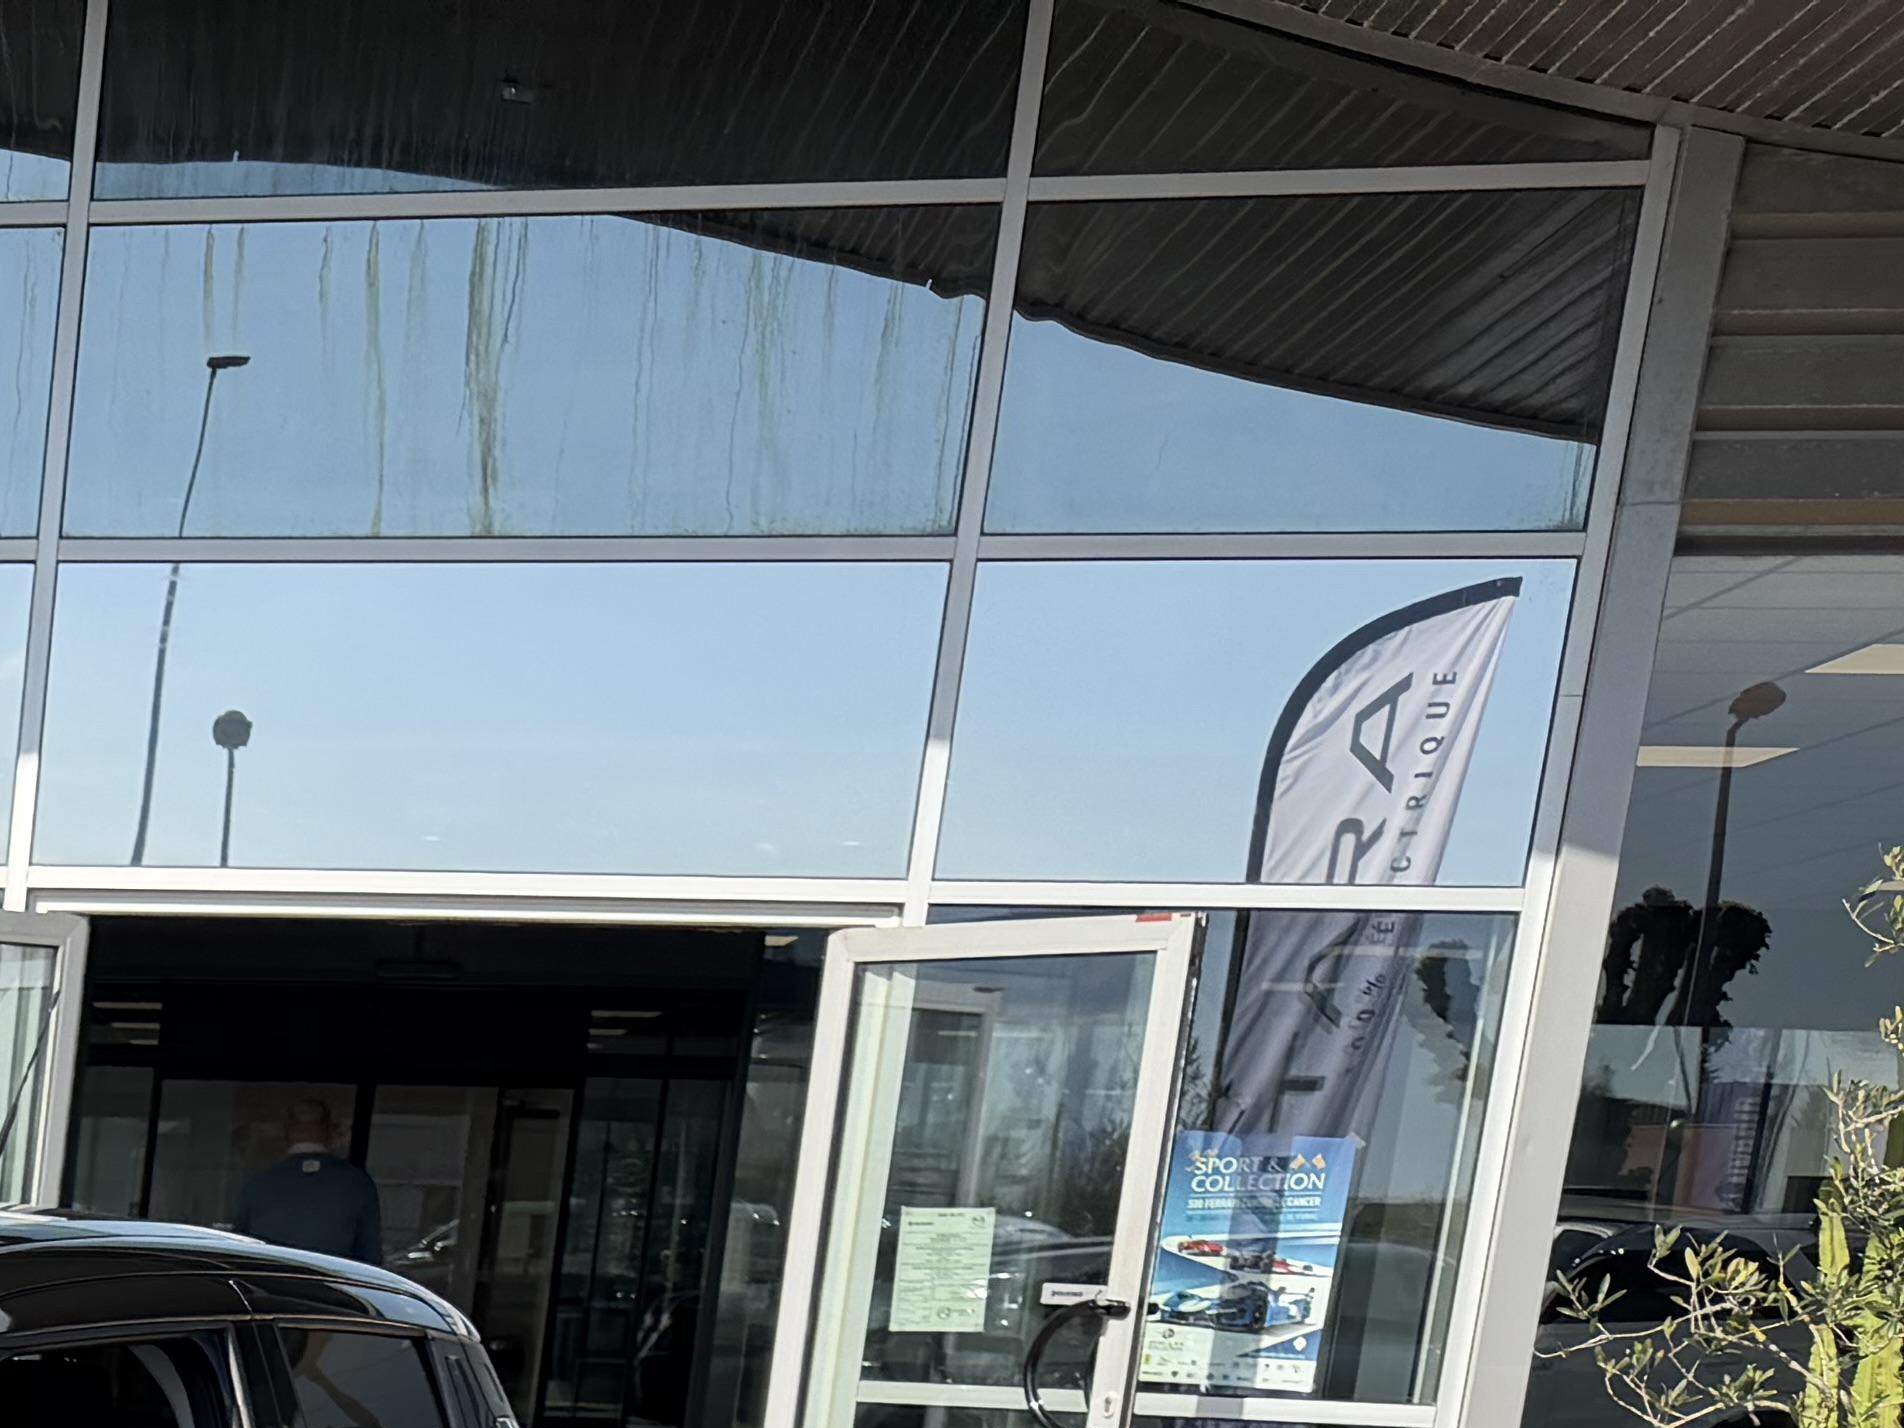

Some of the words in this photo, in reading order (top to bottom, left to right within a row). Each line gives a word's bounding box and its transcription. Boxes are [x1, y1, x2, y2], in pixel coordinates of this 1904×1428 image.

[1372, 670, 1458, 935] ÉCTRIQUE
[1193, 1156, 1263, 1175] SPORT
[1268, 1158, 1282, 1172] &
[1190, 1172, 1326, 1193] COLLECTION
